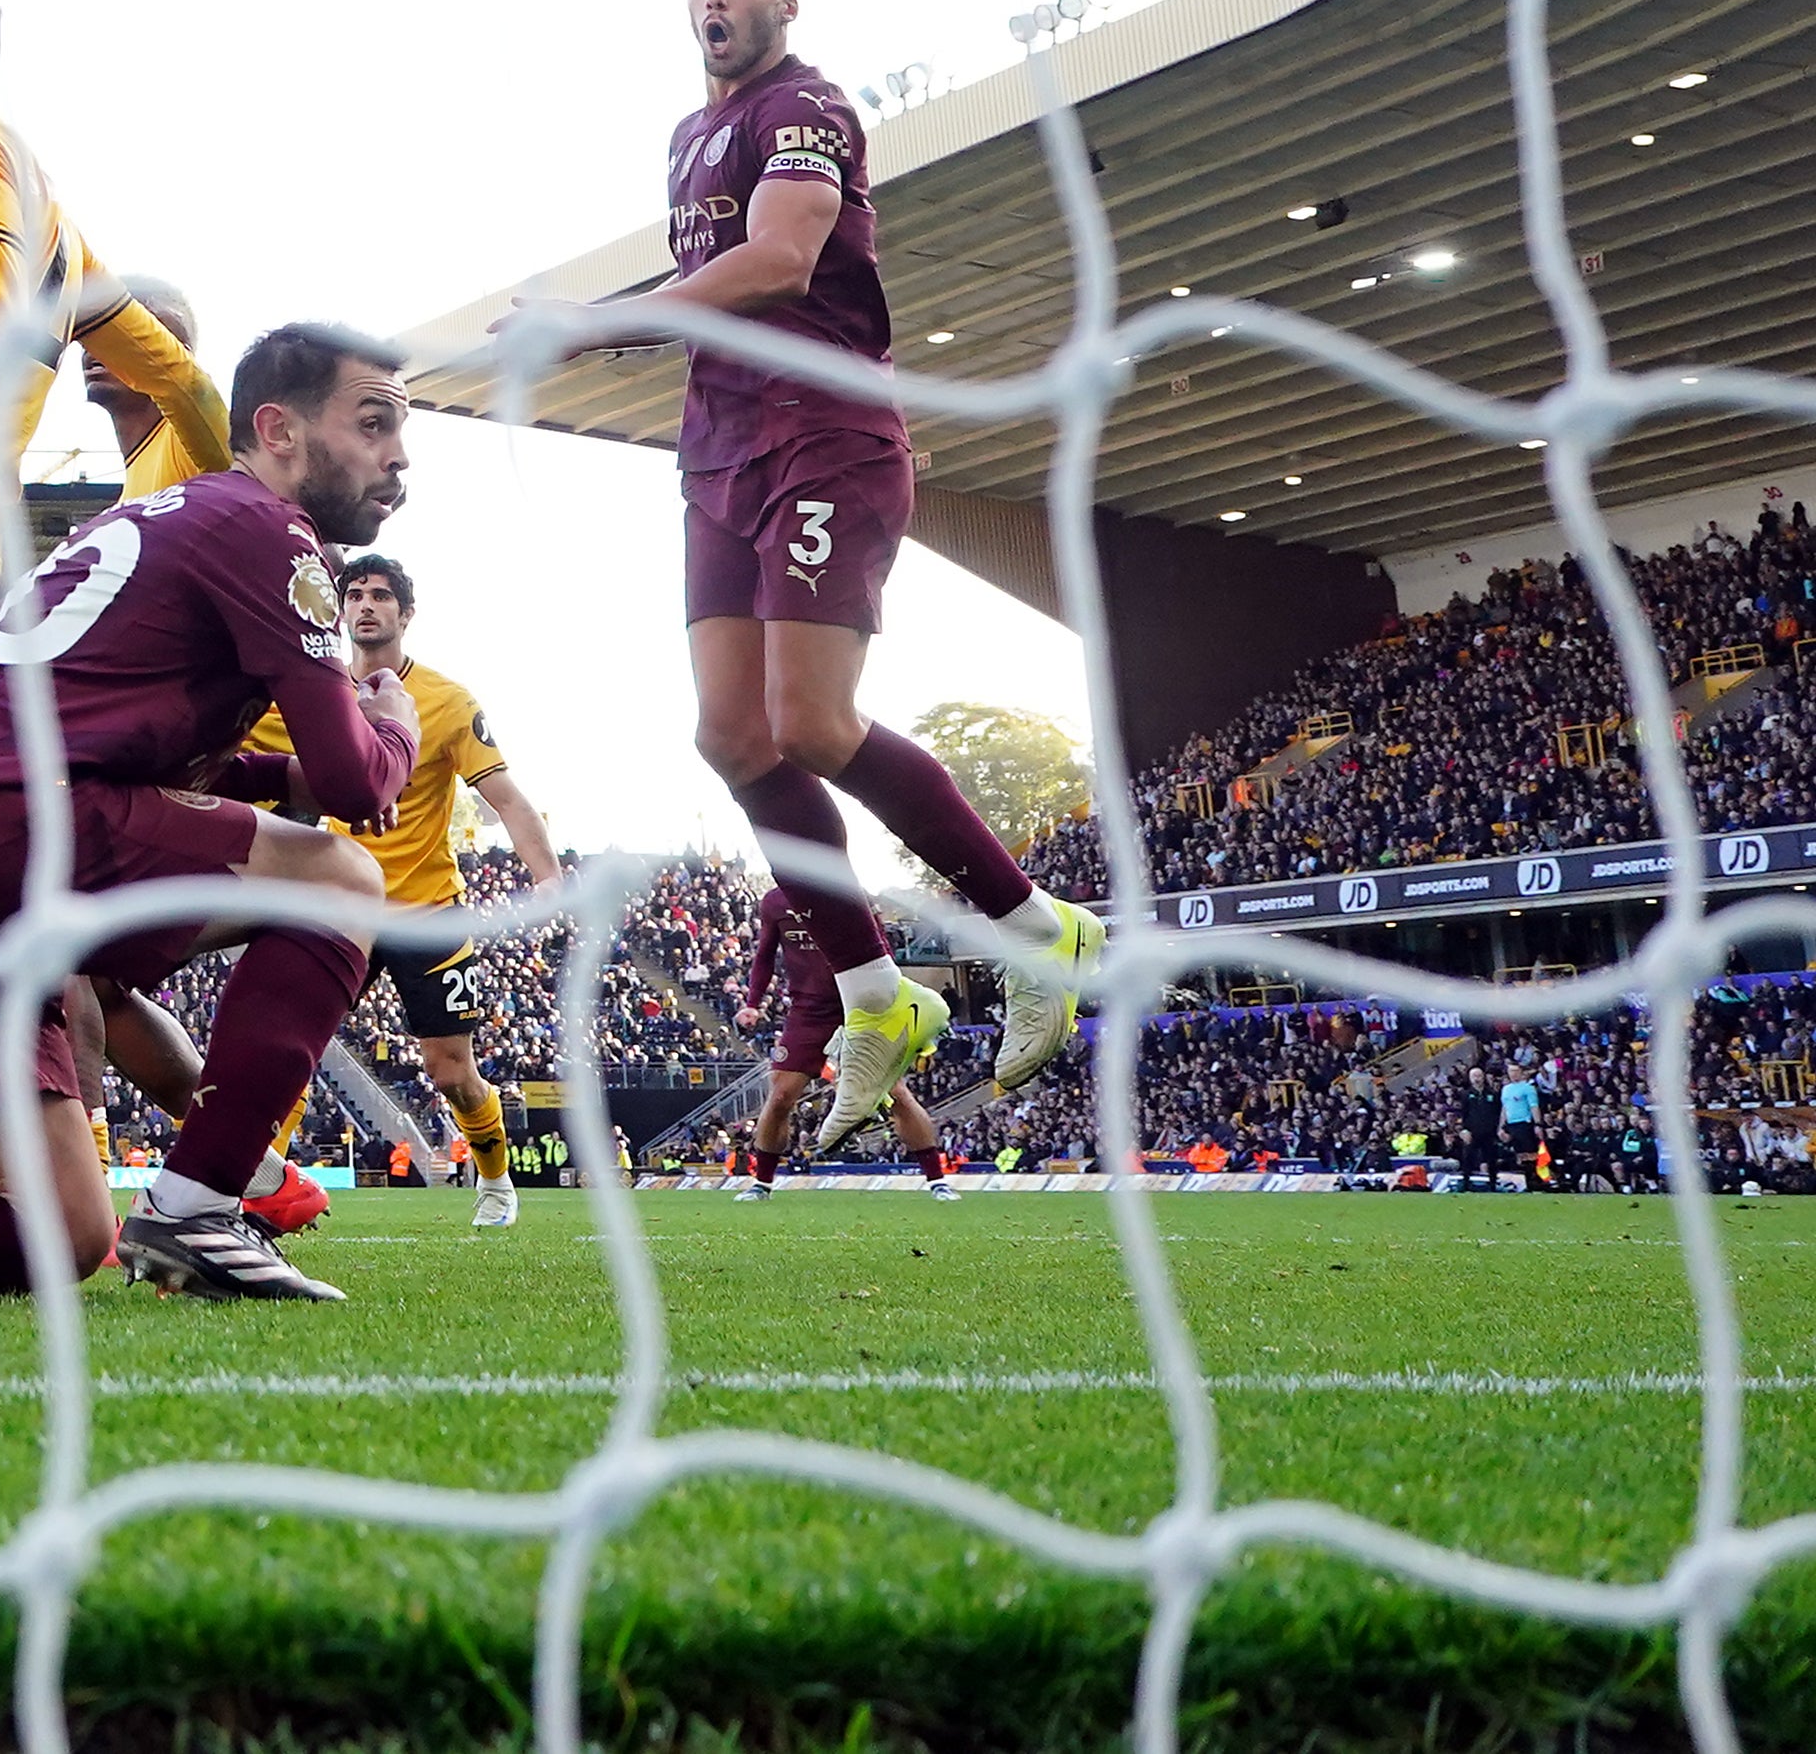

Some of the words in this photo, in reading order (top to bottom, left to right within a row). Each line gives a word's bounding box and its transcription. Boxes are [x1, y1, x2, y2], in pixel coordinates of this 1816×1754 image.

[788, 500, 835, 565] 3
[1591, 857, 1678, 878] JDSPORTS.CO
[1729, 839, 1761, 871] JD
[1404, 875, 1490, 896] JDSPORTS.COM
[1524, 863, 1554, 892] JD
[1237, 894, 1314, 915] JDSPORTS.COM
[1347, 881, 1372, 908] JD
[1185, 900, 1209, 925] JD
[442, 965, 479, 1012] 29
